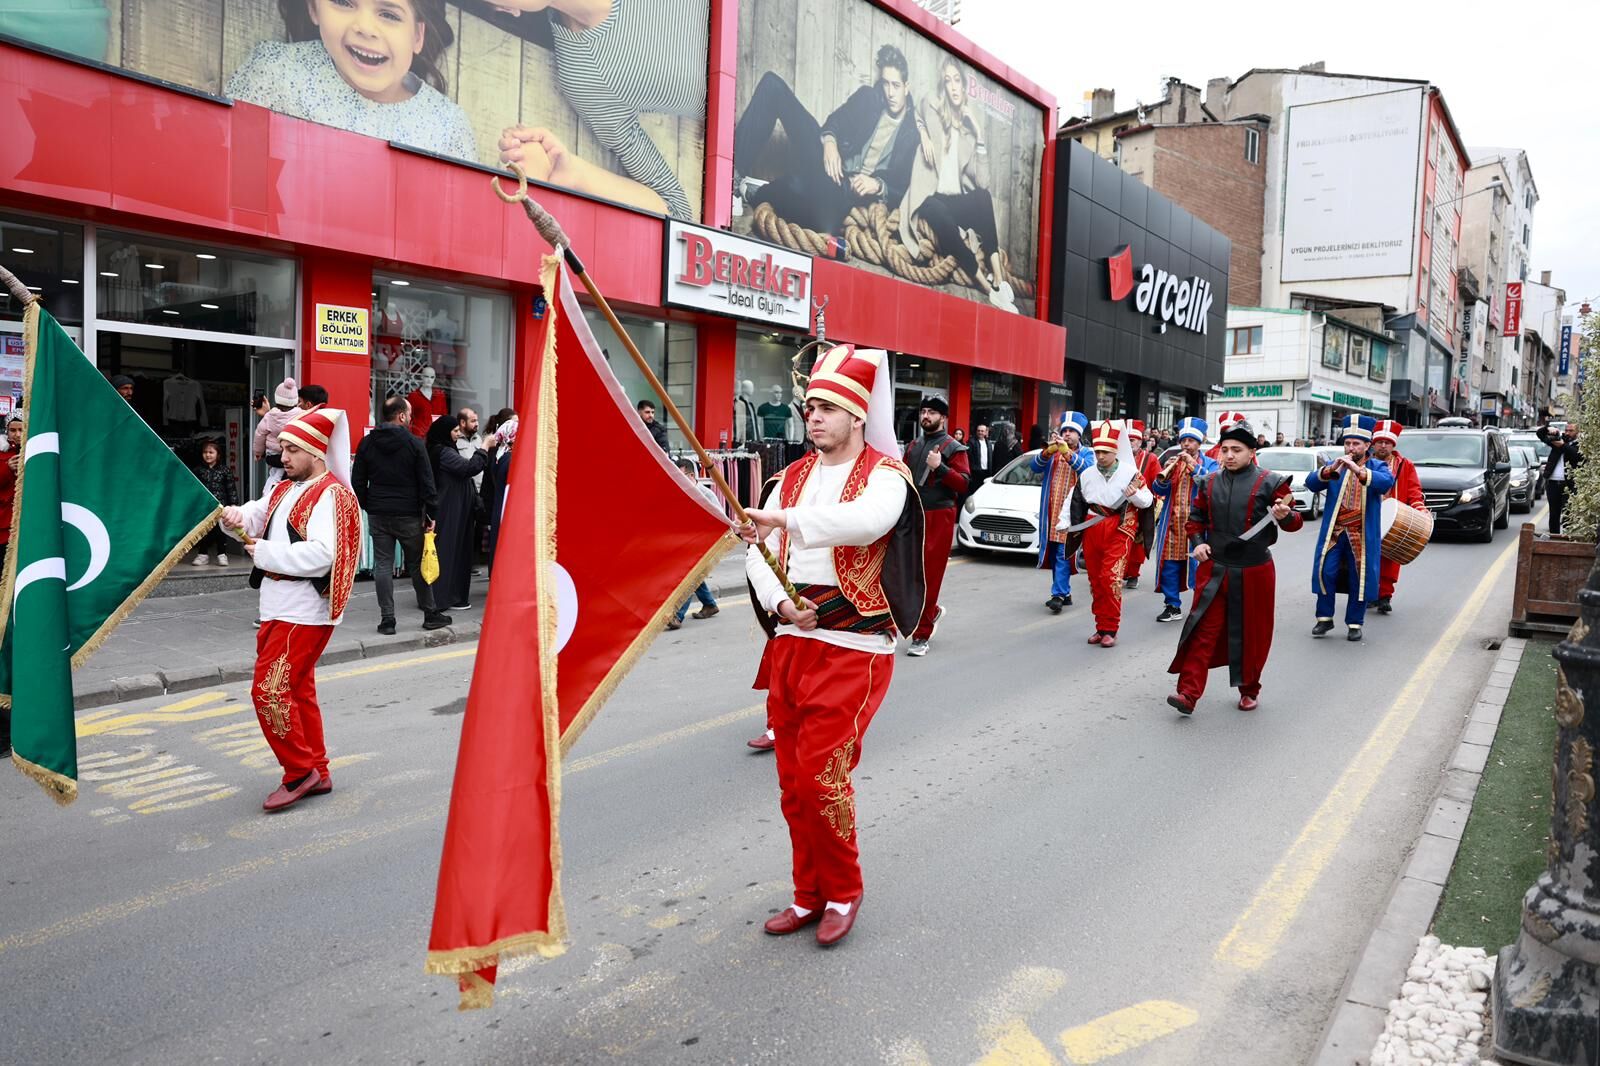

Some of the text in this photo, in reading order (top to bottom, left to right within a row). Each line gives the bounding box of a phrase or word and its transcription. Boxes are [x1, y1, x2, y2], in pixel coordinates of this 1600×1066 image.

[1290, 246, 1313, 255] UYGUN
[1136, 263, 1213, 335] arçelik
[327, 309, 358, 323] ERKEK
[322, 322, 363, 336] BÖLÜMÜ
[320, 334, 364, 348] ÜST KATTADIR
[1246, 384, 1283, 397] PAZARI
